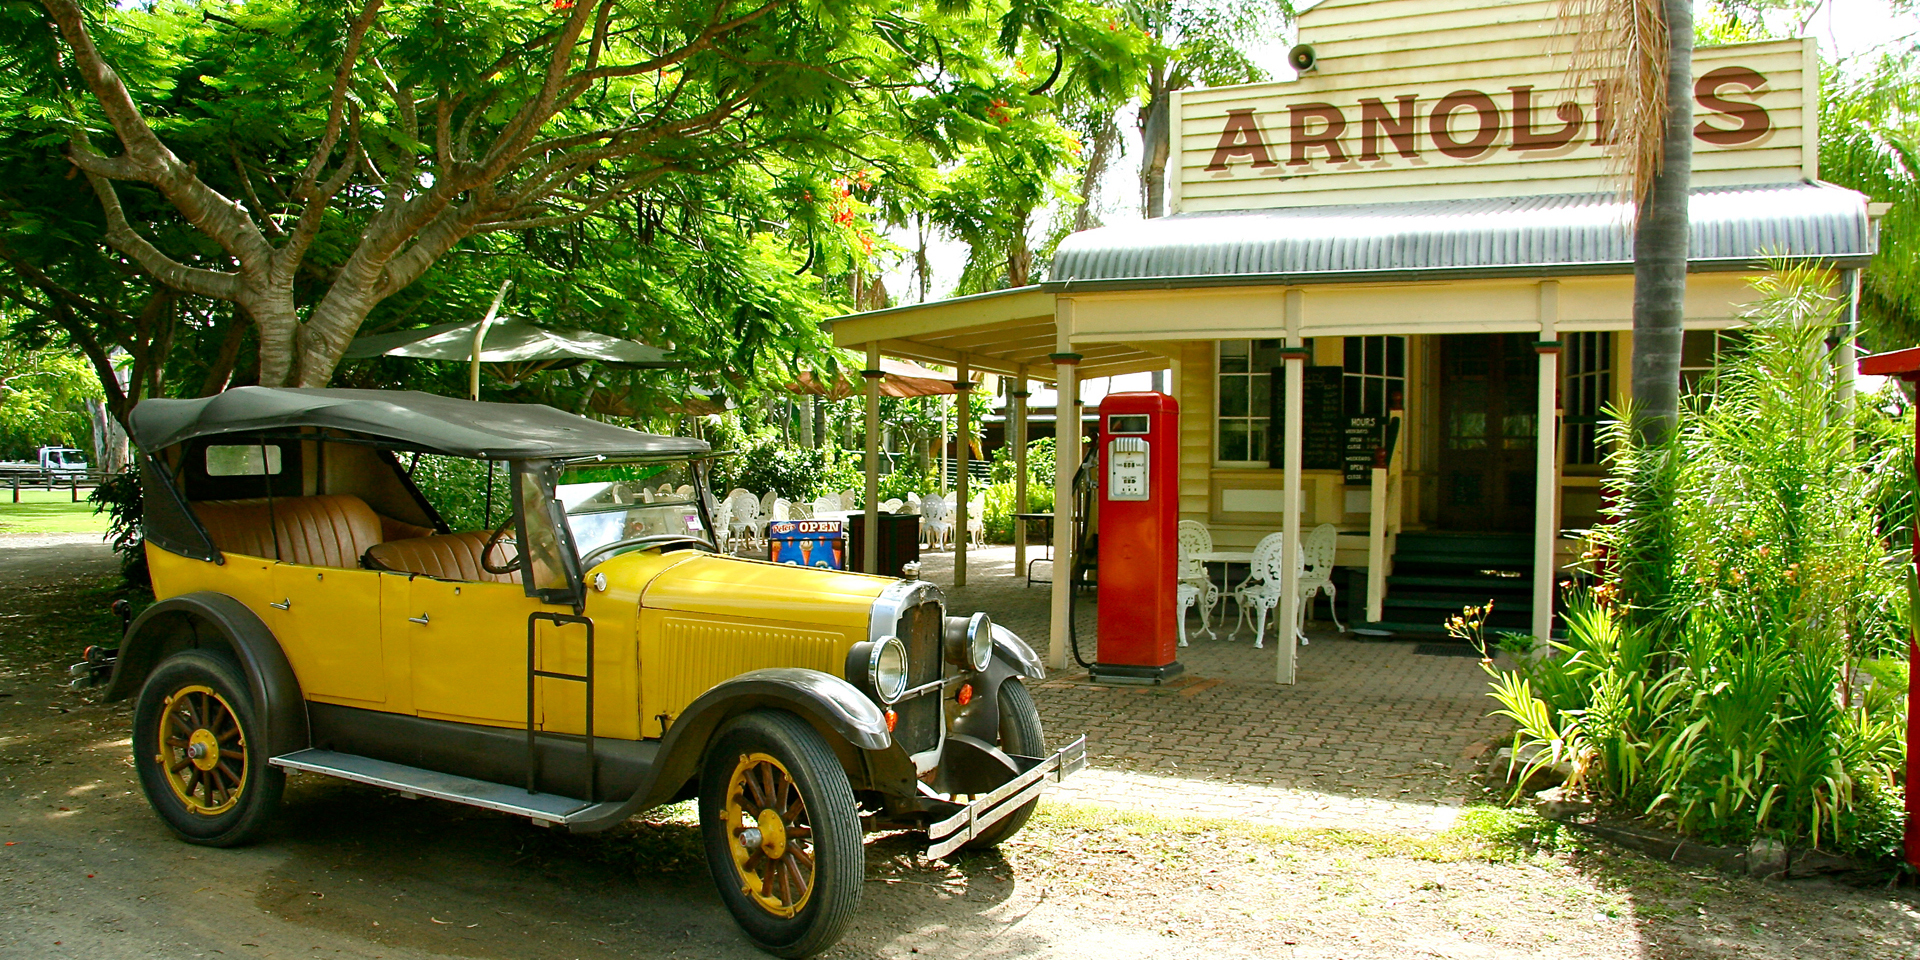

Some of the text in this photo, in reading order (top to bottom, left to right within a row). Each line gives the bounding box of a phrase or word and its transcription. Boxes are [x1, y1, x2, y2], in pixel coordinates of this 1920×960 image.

[1204, 66, 1772, 173] ARNOLS
[1350, 417, 1376, 427] HOURS
[772, 522, 840, 534] Peters OPEN
